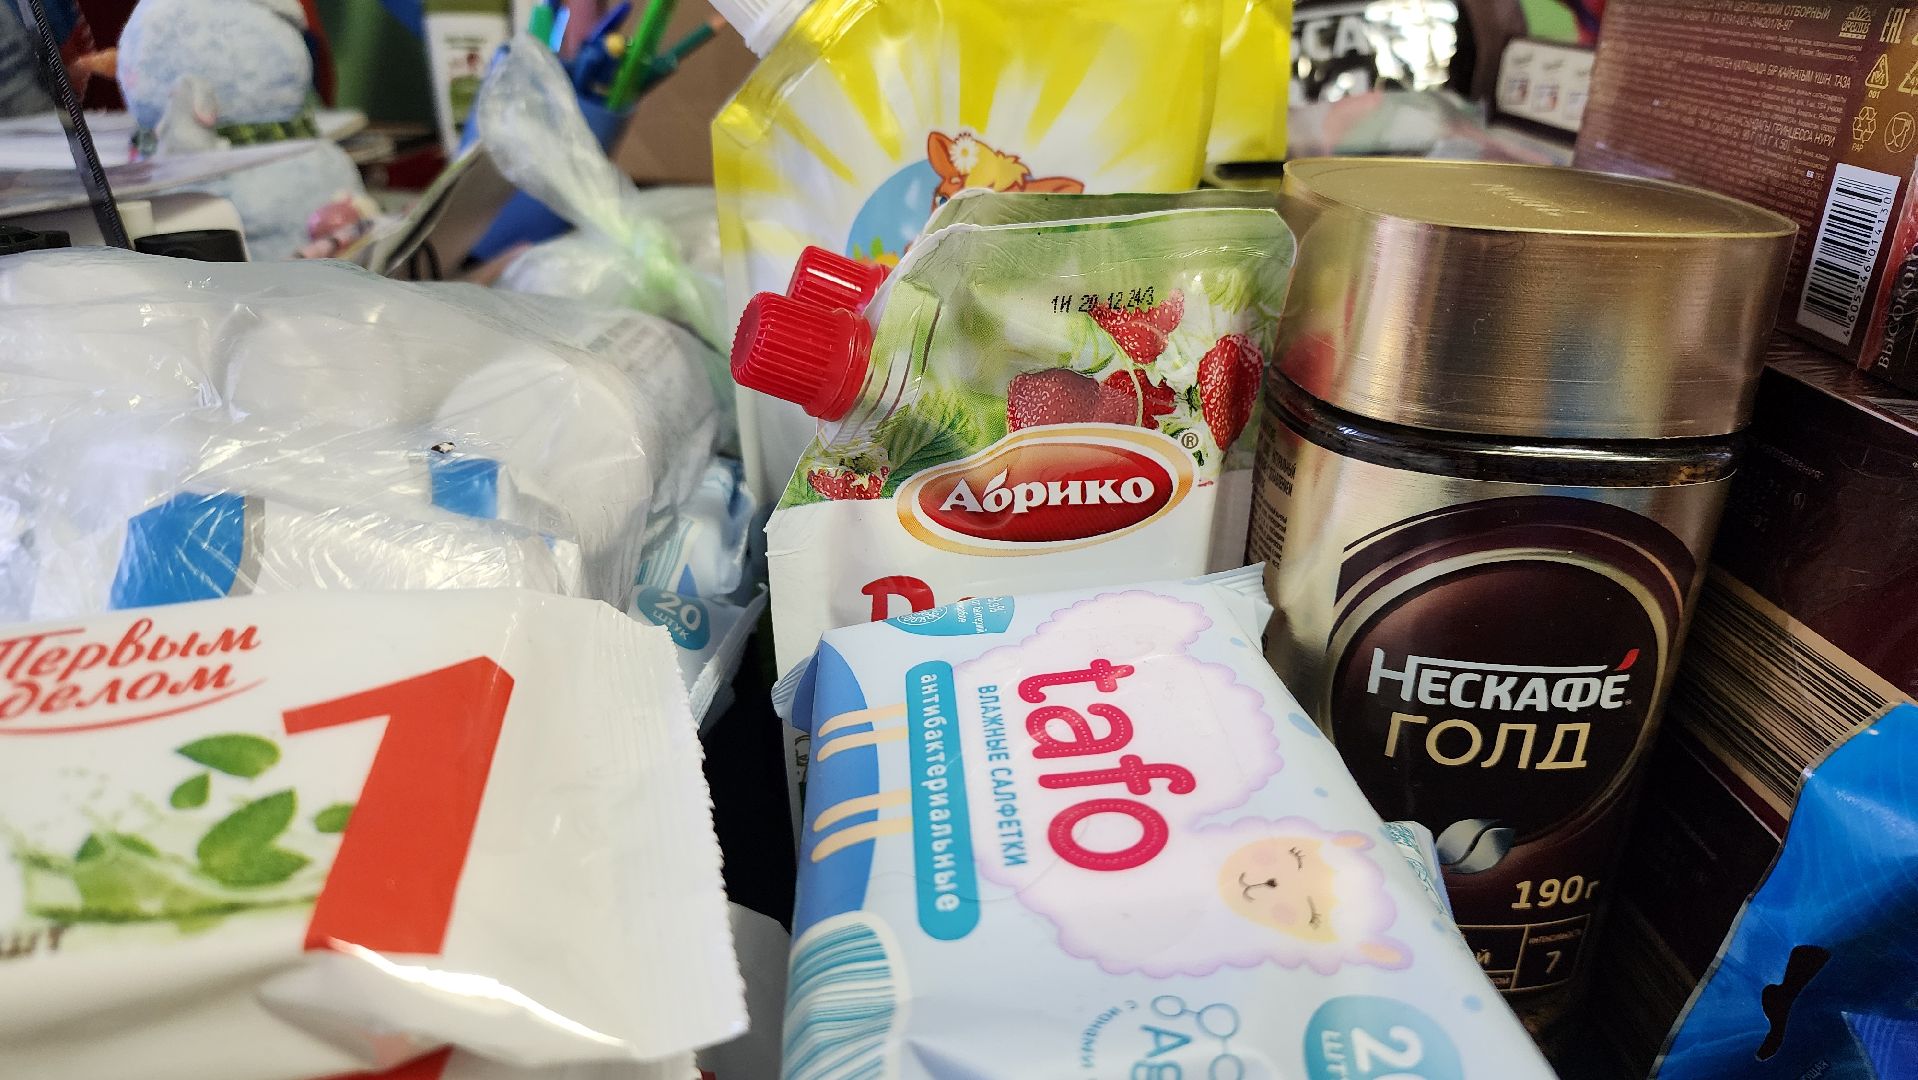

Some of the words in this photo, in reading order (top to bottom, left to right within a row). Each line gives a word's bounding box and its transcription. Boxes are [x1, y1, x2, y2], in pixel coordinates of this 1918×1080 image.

[1784, 5, 1831, 20] ОТБОРНЫЙ
[1814, 133, 1836, 148] НУРИ
[939, 468, 1155, 514] Абрико
[654, 592, 702, 632] 20
[0, 618, 262, 682] Первым
[0, 664, 236, 721] делом
[977, 684, 1010, 762] ВЛАЖНЫЕ
[1384, 711, 1591, 770] ГОЛД
[1018, 658, 1197, 872] tafo
[919, 673, 961, 913] антибактериальные
[989, 767, 1029, 867] САЛФЕТКИ
[1511, 875, 1600, 910] 190г
[1546, 950, 1562, 975] 7
[1350, 1026, 1422, 1080] 2
